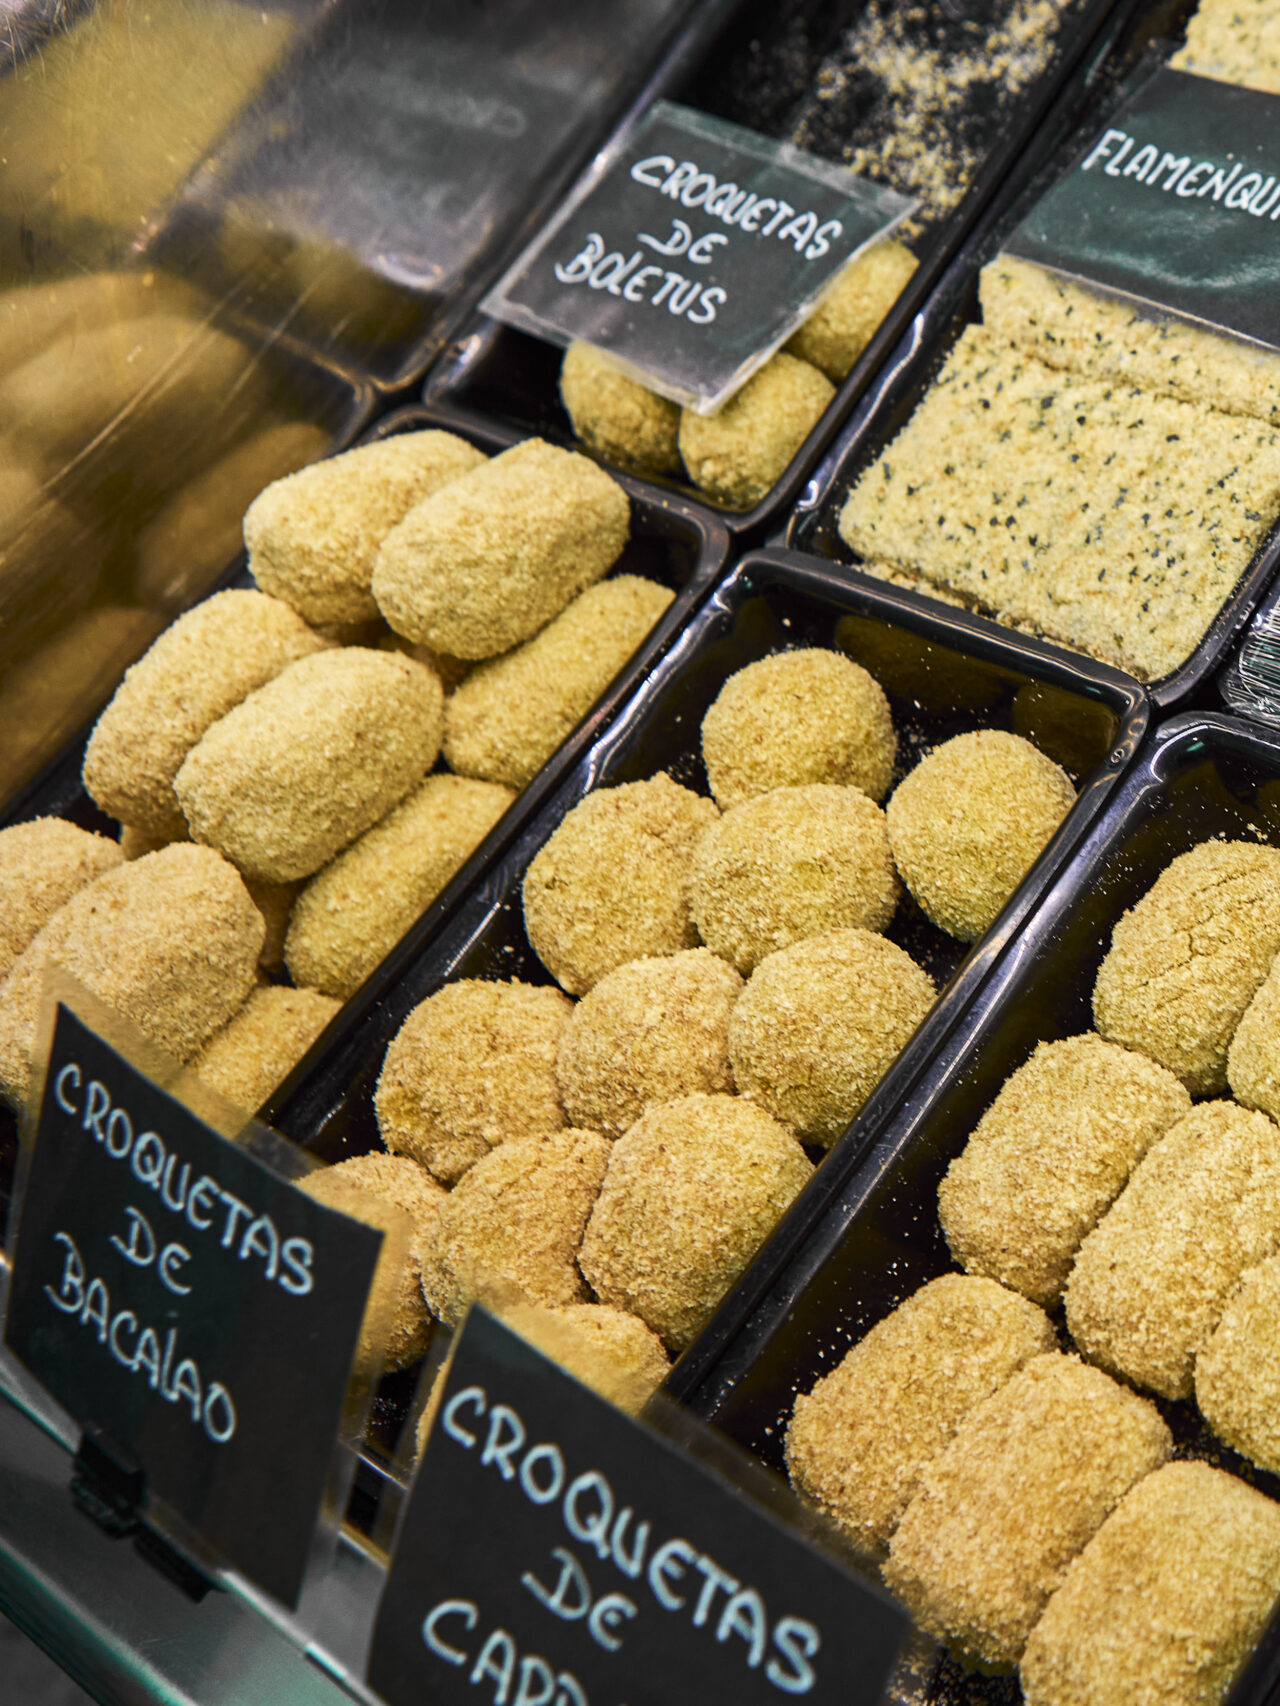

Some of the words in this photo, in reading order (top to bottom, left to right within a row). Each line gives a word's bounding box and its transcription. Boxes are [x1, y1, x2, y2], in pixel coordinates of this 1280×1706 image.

[631, 155, 843, 260] CROQUETAS
[637, 218, 729, 264] DE
[555, 232, 728, 324] BOLETUS
[54, 1062, 315, 1296] CROQUETAS
[109, 1205, 193, 1296] DE
[43, 1231, 238, 1443] BACALAO
[441, 1386, 821, 1695] CROQUETAS
[521, 1547, 638, 1651] DE
